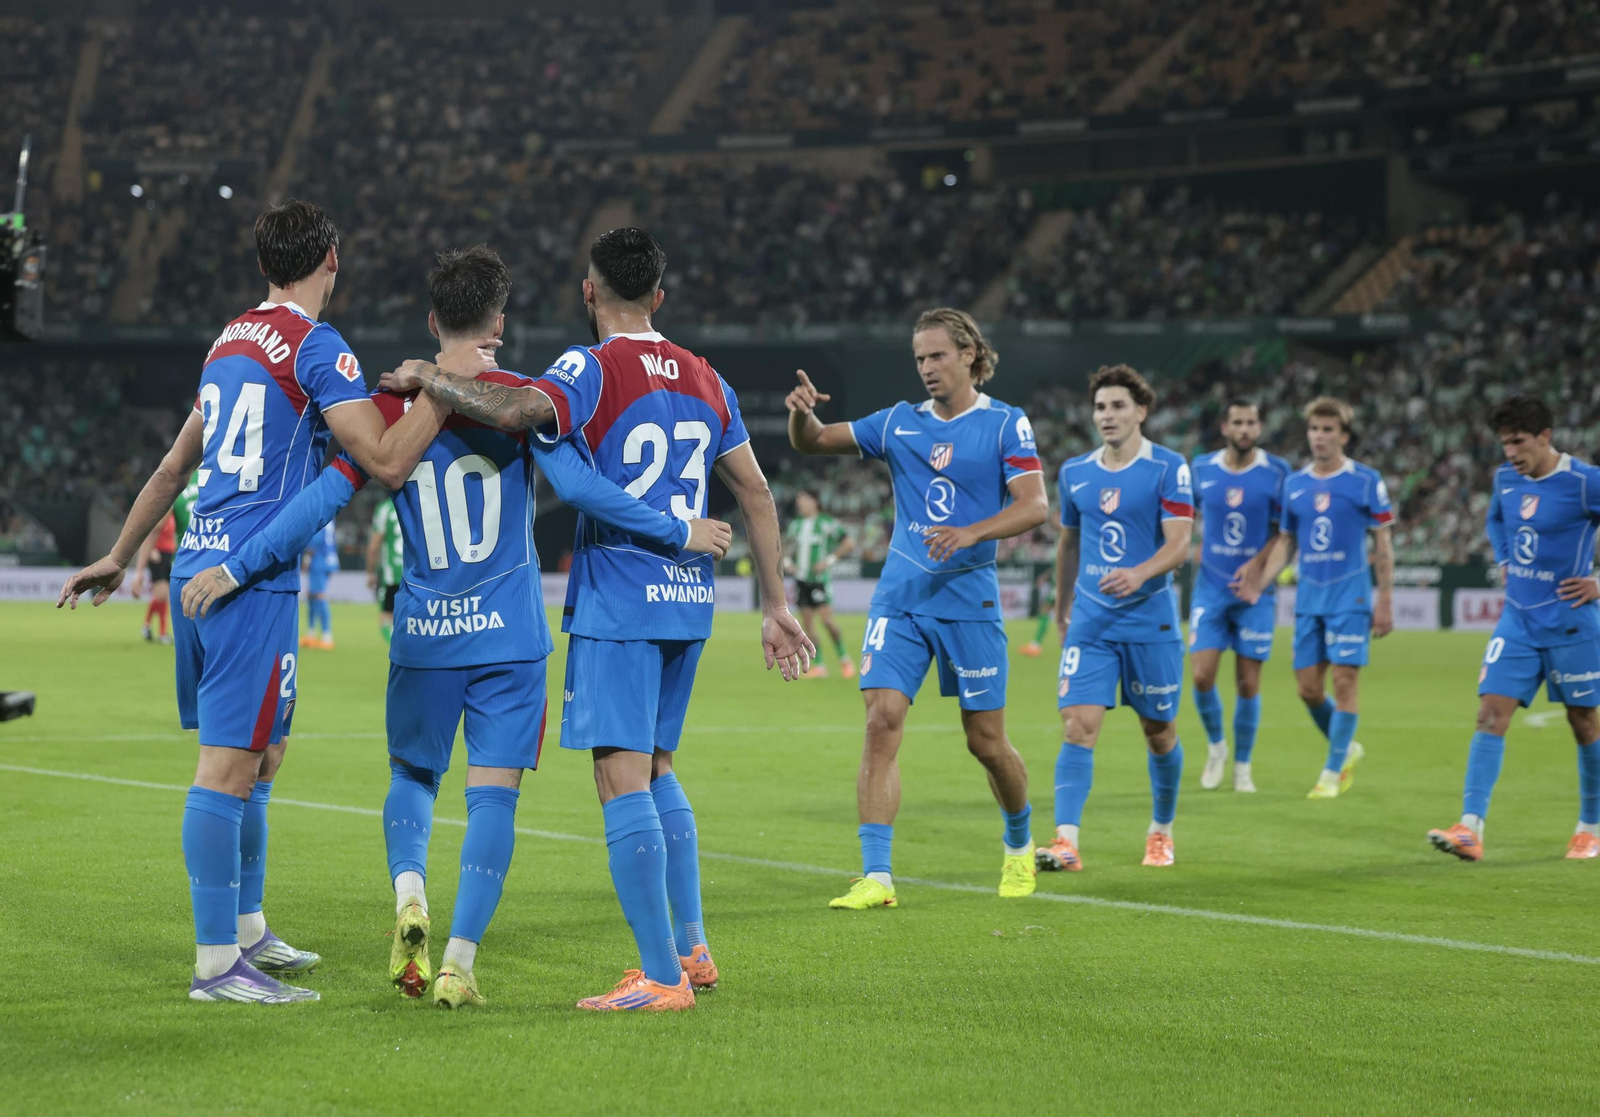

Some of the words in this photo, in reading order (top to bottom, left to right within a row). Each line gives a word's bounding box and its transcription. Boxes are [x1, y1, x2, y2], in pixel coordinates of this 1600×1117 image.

[198, 382, 266, 491] 24
[623, 420, 712, 520] 23
[407, 454, 501, 570] 10
[662, 565, 701, 584] VISIT
[427, 596, 482, 618] VISIT
[646, 584, 714, 603] RWANDA
[407, 611, 505, 637] RWANDA
[280, 652, 297, 699] 2
